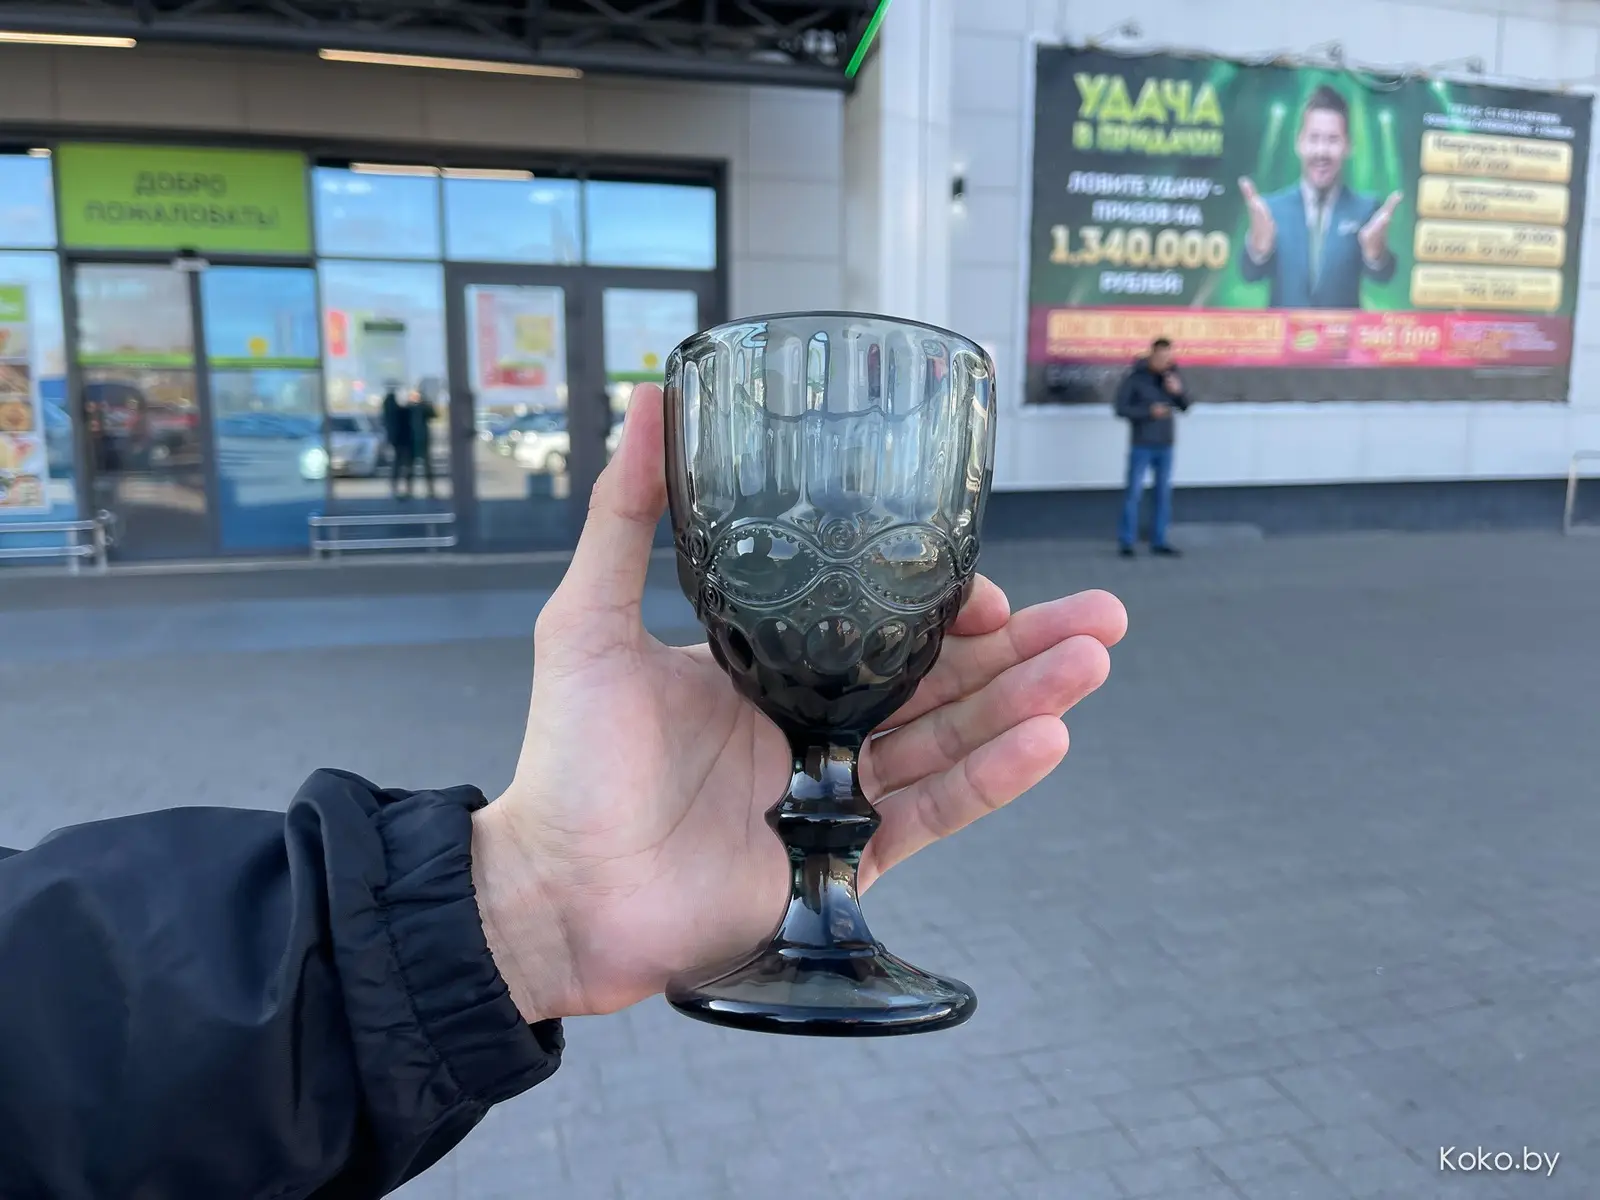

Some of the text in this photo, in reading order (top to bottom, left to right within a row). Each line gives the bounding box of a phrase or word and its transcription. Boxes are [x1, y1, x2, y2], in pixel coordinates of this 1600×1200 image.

[1073, 72, 1224, 126] УДАЧА
[135, 170, 227, 197] ДОБРО
[1067, 170, 1146, 196] ЛОВИТЕ
[1092, 200, 1203, 226] ПРИЗОВ НА
